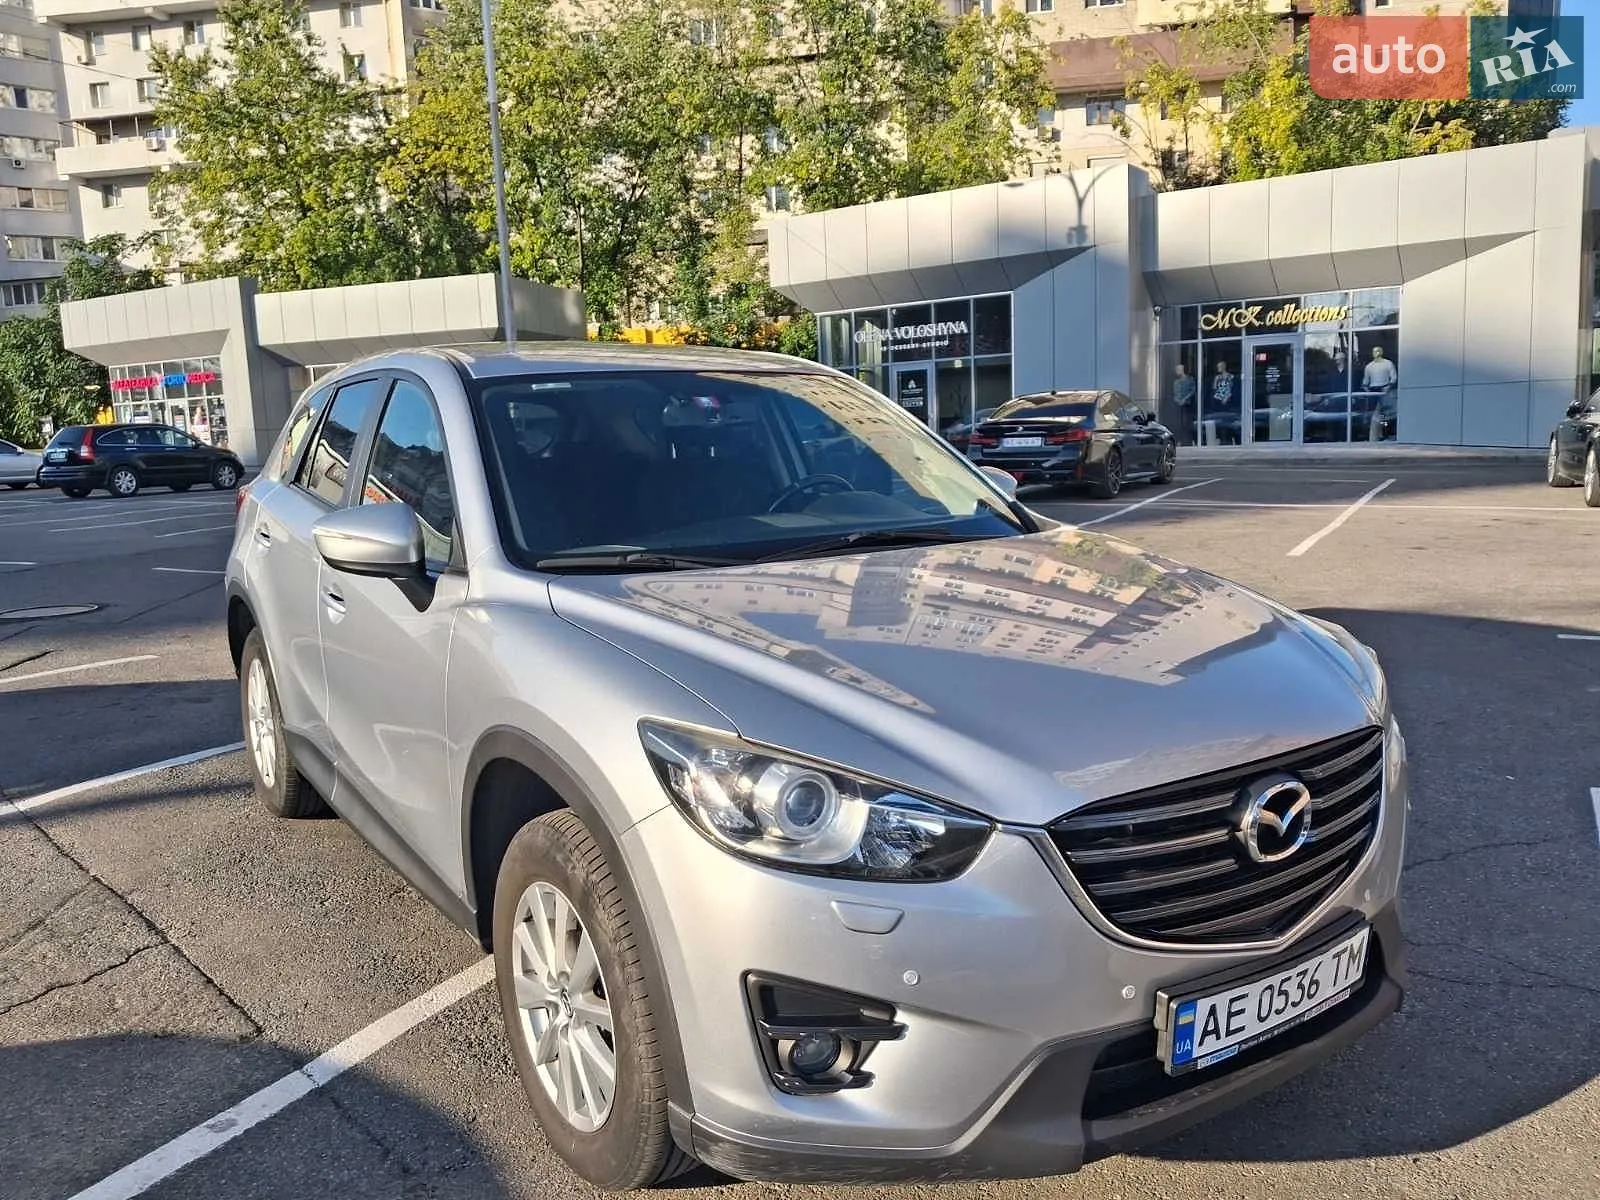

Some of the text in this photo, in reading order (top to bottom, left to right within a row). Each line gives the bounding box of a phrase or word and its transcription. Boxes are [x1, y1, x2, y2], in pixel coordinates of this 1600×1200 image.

[1265, 304, 1348, 326] collections
[894, 321, 968, 339] VOLOSHYNA
[1198, 992, 1249, 1048] AE
[1256, 961, 1322, 1023] 0536
[1331, 936, 1366, 988] TM
[1176, 1039, 1192, 1054] UA
